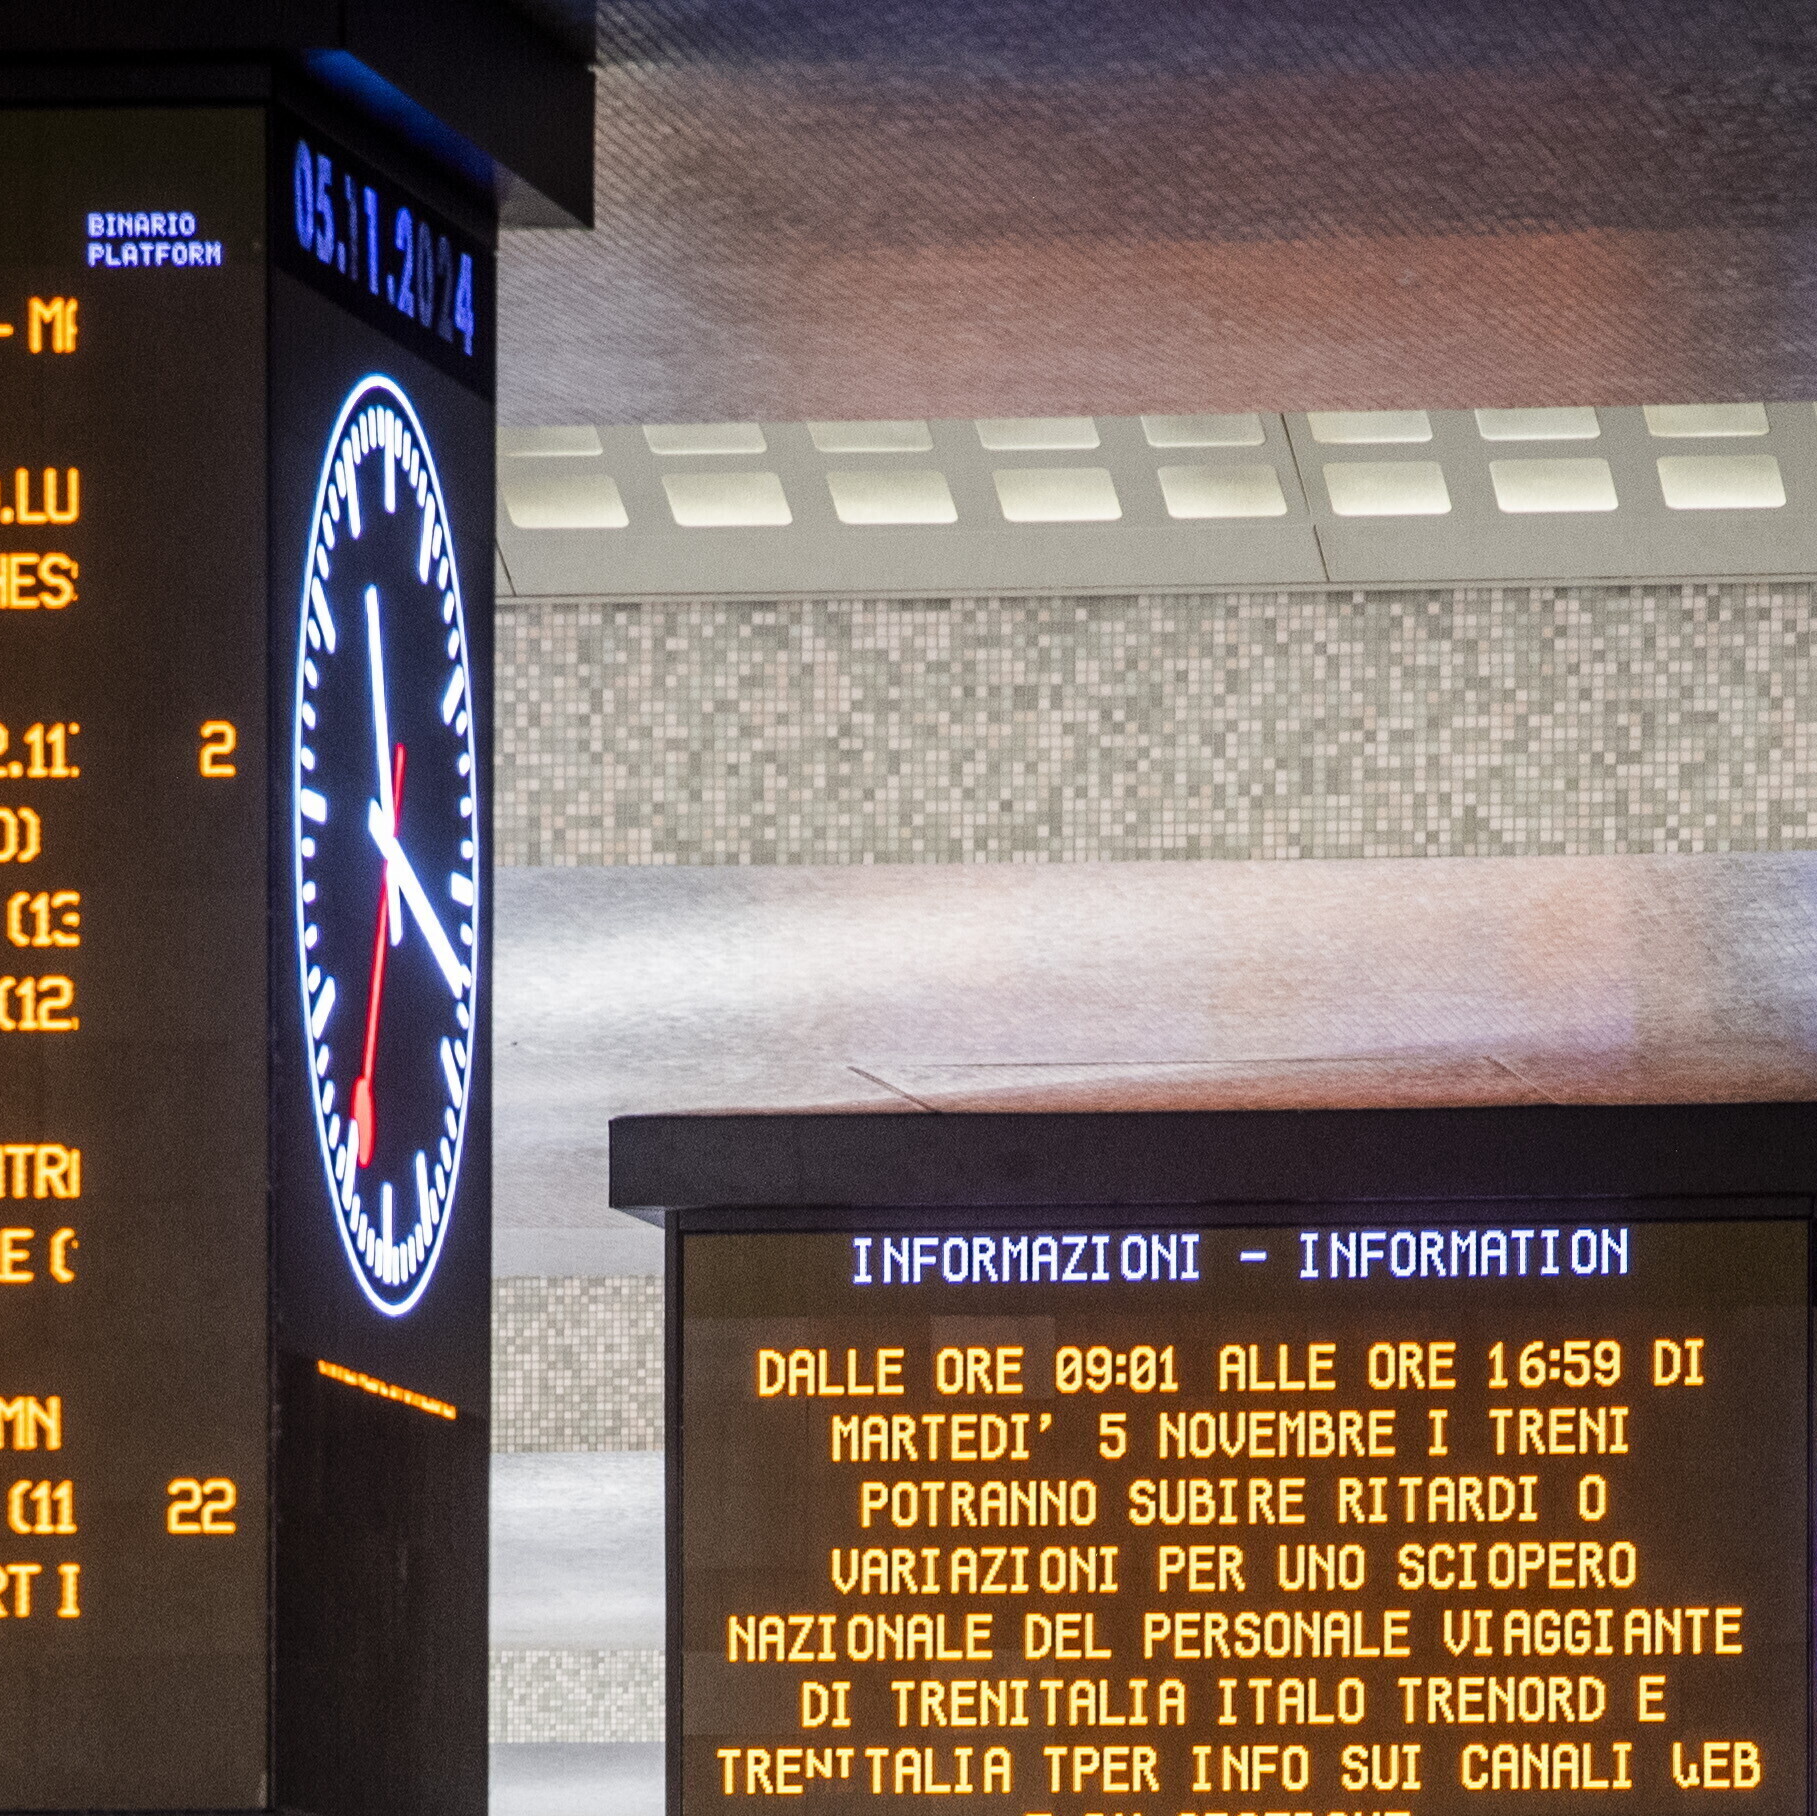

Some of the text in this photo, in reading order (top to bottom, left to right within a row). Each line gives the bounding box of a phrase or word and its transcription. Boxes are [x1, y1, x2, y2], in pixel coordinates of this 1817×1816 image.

[88, 212, 195, 237] BINARIO
[88, 241, 222, 268] PLATFORM
[199, 720, 236, 777] 2
[853, 1234, 1199, 1285] INFORMAZIONI
[1300, 1228, 1628, 1279] INFORMATION
[755, 1338, 1704, 1399] DALLE ORE 09:01 ALLE ORE 16:59 DI
[831, 1405, 1629, 1462] MARTEDI' 5 NOVEMBRE I TRENI
[167, 1477, 236, 1534] 22
[857, 1474, 1608, 1528] POTRANNO SUBIRE RITARDI O
[831, 1540, 1638, 1595] VARIAZIONI PER UNO SCIOPERO
[726, 1606, 1743, 1663] NAZIONALE DEL PERSONALE VIAGGIANTE
[799, 1674, 1666, 1732] DI TRENITALIA ITALO TRENORD E
[1042, 1743, 1160, 1795] TPER
[1191, 1744, 1311, 1794] INFO
[1340, 1742, 1422, 1794] SUI
[1459, 1741, 1632, 1792] CANALI
